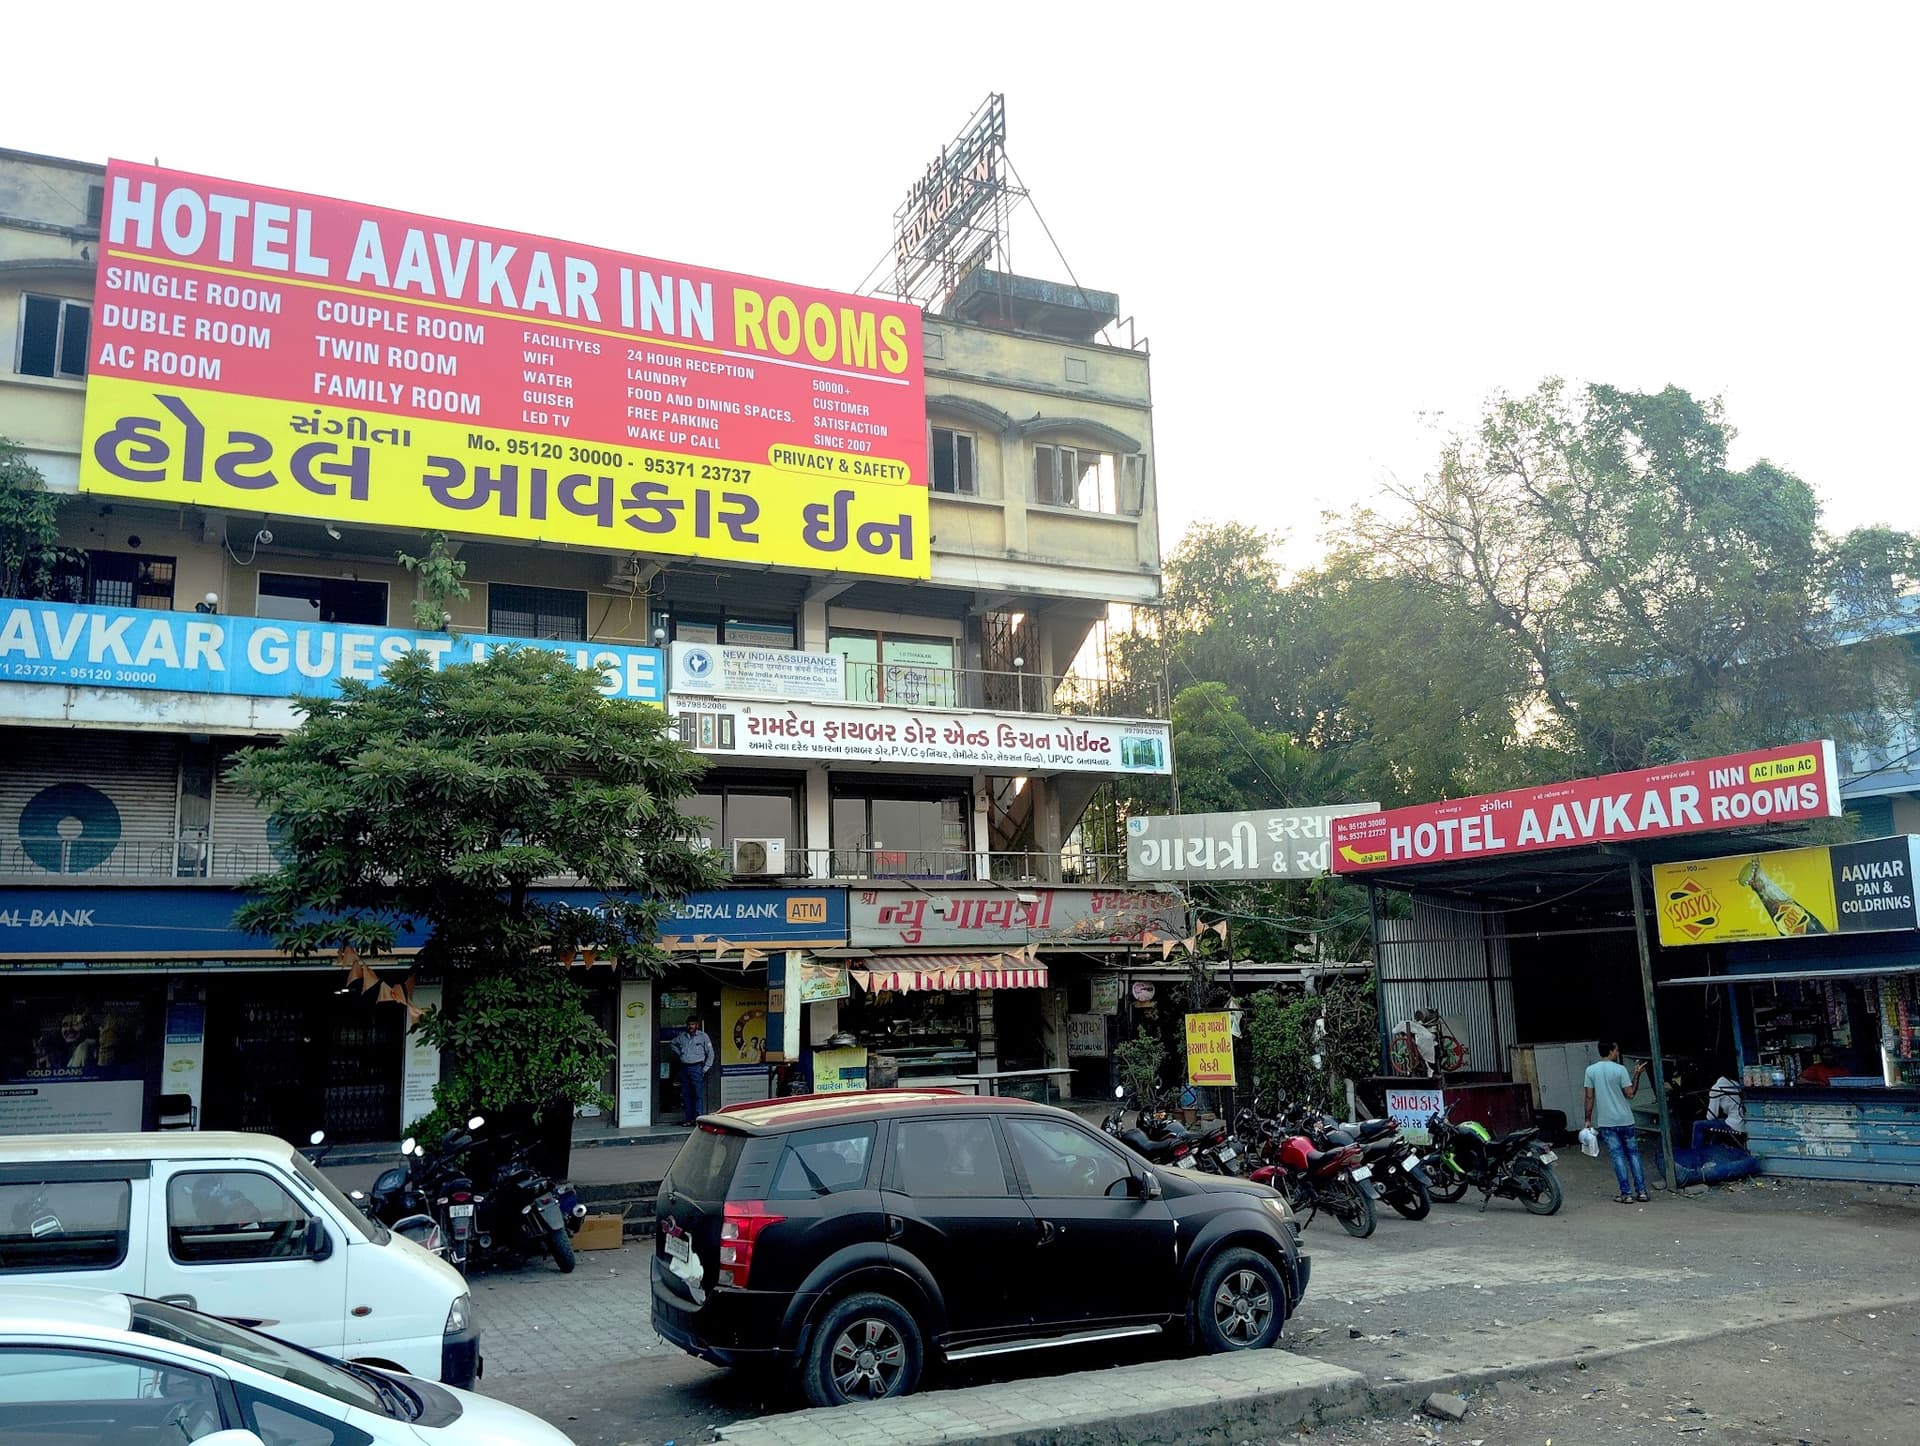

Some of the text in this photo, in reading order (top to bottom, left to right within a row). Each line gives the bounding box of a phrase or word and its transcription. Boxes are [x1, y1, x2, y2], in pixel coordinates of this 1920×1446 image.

[108, 176, 908, 374] HOTEL AAVKAR INN ROOMS
[106, 267, 281, 314] SINGLE ROOM
[102, 304, 270, 350] DUBLE ROOM
[316, 300, 485, 345] COUPLE ROOM
[523, 331, 601, 355] FACILITYES
[99, 344, 221, 381] AC ROOM
[316, 336, 457, 376] TWIN ROOM
[523, 351, 554, 367] WIFI
[627, 349, 754, 379] 24 HOUR RECEPTION
[523, 370, 573, 388] WATER
[627, 368, 687, 388] LAUNDRY
[813, 379, 851, 395] 50000+
[313, 373, 481, 416] FAMILY ROOM
[522, 391, 574, 409] GUISER
[627, 387, 794, 424] FOOD AND DINING SPACES.
[627, 406, 718, 430] FREE PARKING
[813, 398, 869, 416] CUSTOMER
[290, 409, 411, 447] સંગીતા
[522, 410, 570, 428] LED TV
[813, 416, 887, 437] SATISFACTION
[627, 426, 720, 450] WAKE UP CALL
[813, 434, 871, 453] SINCE 2007
[467, 434, 500, 452] Mo.
[507, 438, 562, 459] 95120
[569, 446, 623, 467] 30000
[644, 457, 694, 478] 95371
[701, 464, 751, 484] 23737
[773, 448, 905, 480] PRIVACY & SAFETY
[94, 393, 913, 560] હોટલ આવકાર ઈન
[722, 651, 837, 667] NEW INDIA ASSURANCE
[13, 664, 57, 677] 23737
[70, 668, 112, 681] 95120
[115, 670, 156, 683] 30000
[775, 673, 810, 682] Assurance
[748, 710, 1112, 753] રામદેવ ફાયબર ડોર એન્ડ કિચન પોઈન્ટ
[1048, 754, 1074, 764] UPVC
[1708, 766, 1744, 790] INN
[1754, 766, 1768, 778] AC
[1776, 762, 1795, 775] Non
[1797, 759, 1812, 771] AC
[1480, 799, 1513, 812] સંગીતા
[1390, 783, 1819, 861] HOTEL AAVKAR ROOMS
[1140, 821, 1260, 871] ગાયત્રી
[1272, 851, 1288, 872] &
[1841, 860, 1904, 882] AAVKAR
[1855, 881, 1893, 897] PAN &
[736, 903, 778, 919] BANK
[792, 903, 822, 918] ATM
[1673, 894, 1711, 923] SOSYO
[1841, 895, 1911, 914] COLDRINKS
[30, 909, 96, 927] BANK
[26, 1068, 83, 1077] GOLD LOANS
